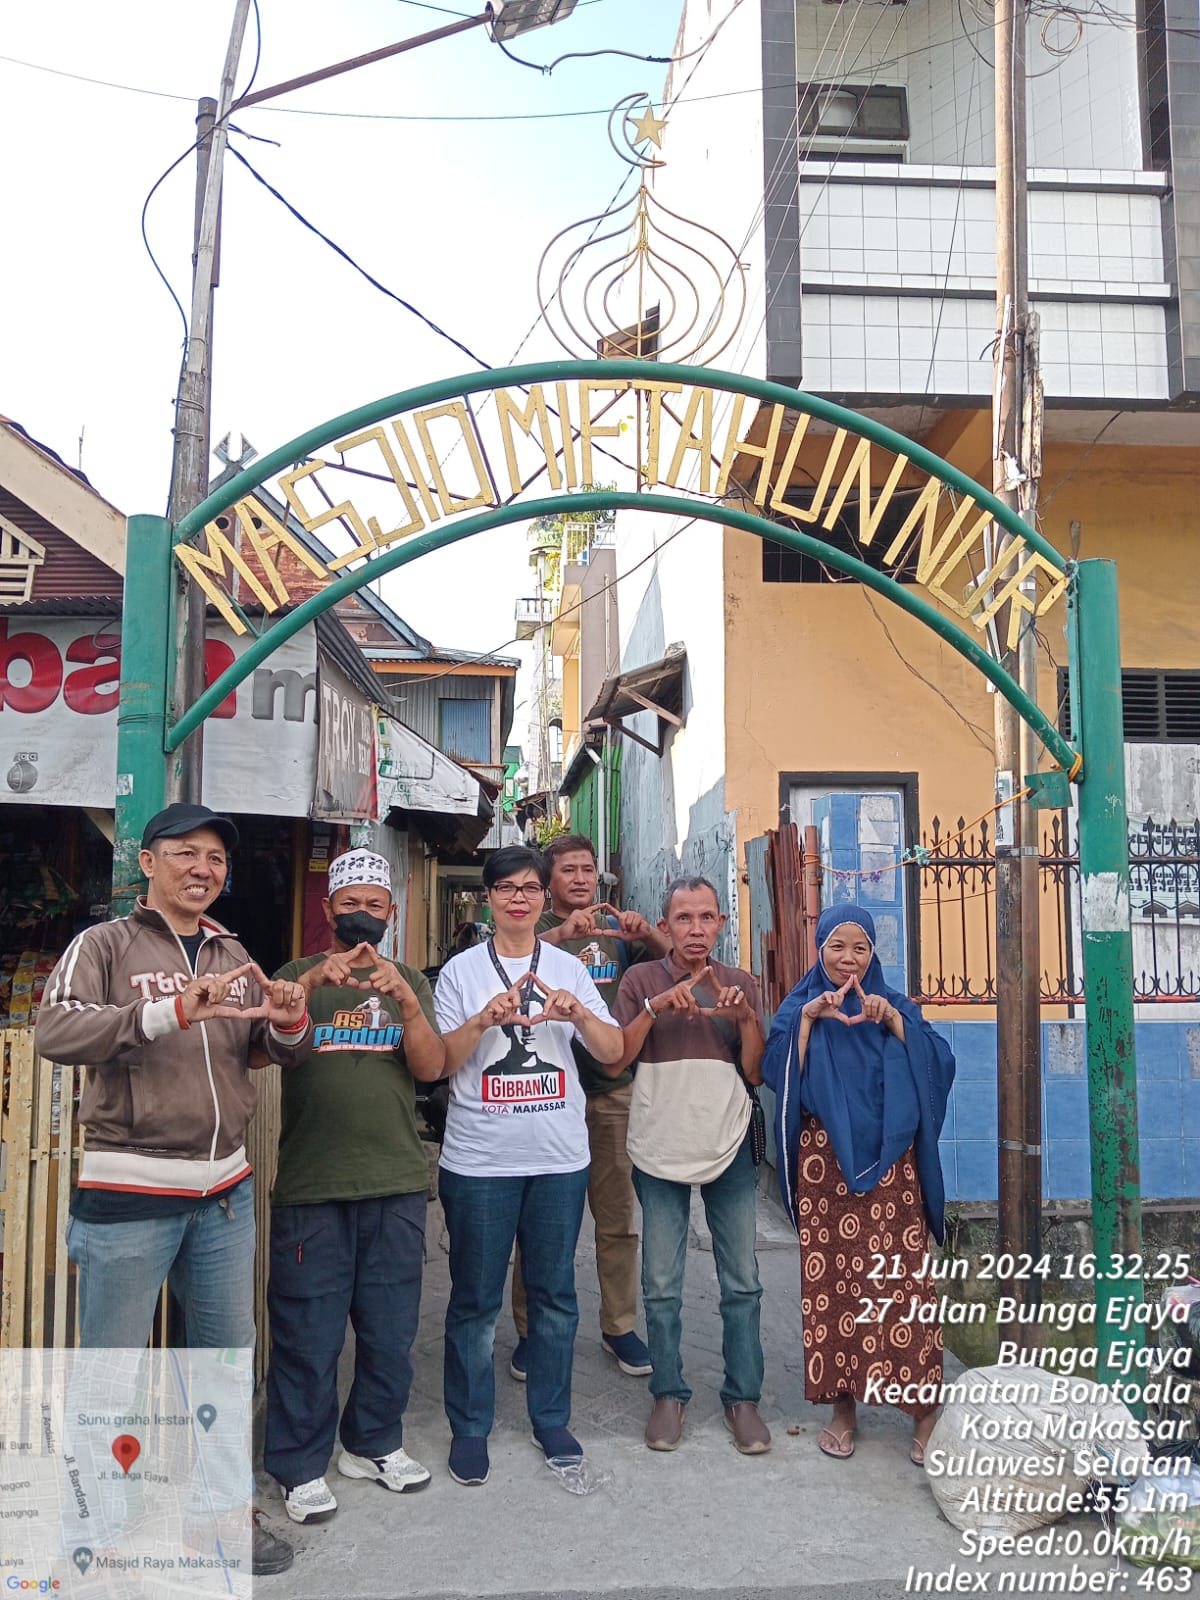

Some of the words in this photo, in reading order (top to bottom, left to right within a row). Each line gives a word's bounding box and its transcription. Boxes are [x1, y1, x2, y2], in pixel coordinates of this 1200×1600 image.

[173, 402, 494, 636] MASJID
[335, 1012, 364, 1028] AS
[312, 1025, 402, 1048] Peduli
[482, 1105, 509, 1114] KOTA
[513, 1101, 566, 1114] MAKASSAR
